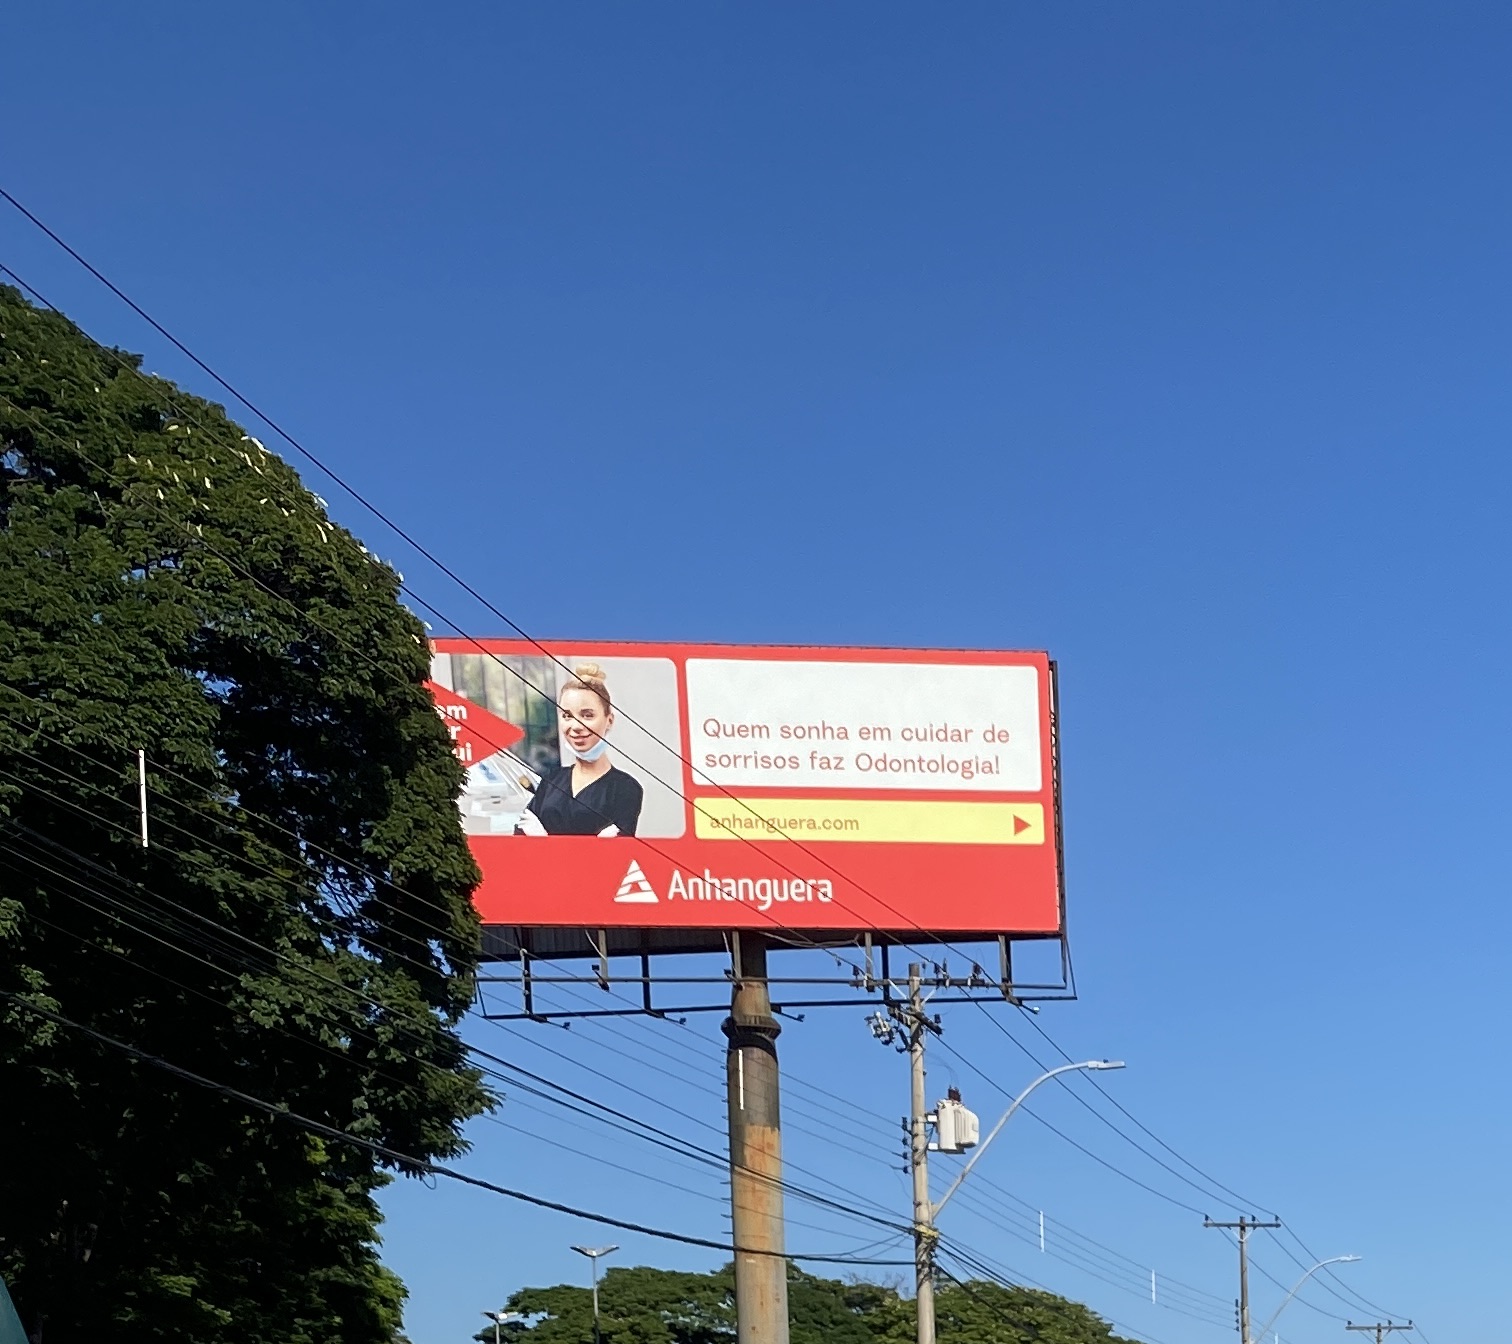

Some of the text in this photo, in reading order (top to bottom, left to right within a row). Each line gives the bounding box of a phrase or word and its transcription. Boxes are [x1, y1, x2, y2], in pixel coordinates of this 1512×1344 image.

[703, 718, 1010, 744] Quem sonha em cuidar de
[705, 751, 1001, 780] sorrisos faz Odontologia!
[710, 814, 860, 834] anhanguera.com
[668, 868, 833, 911] Anhanguera
